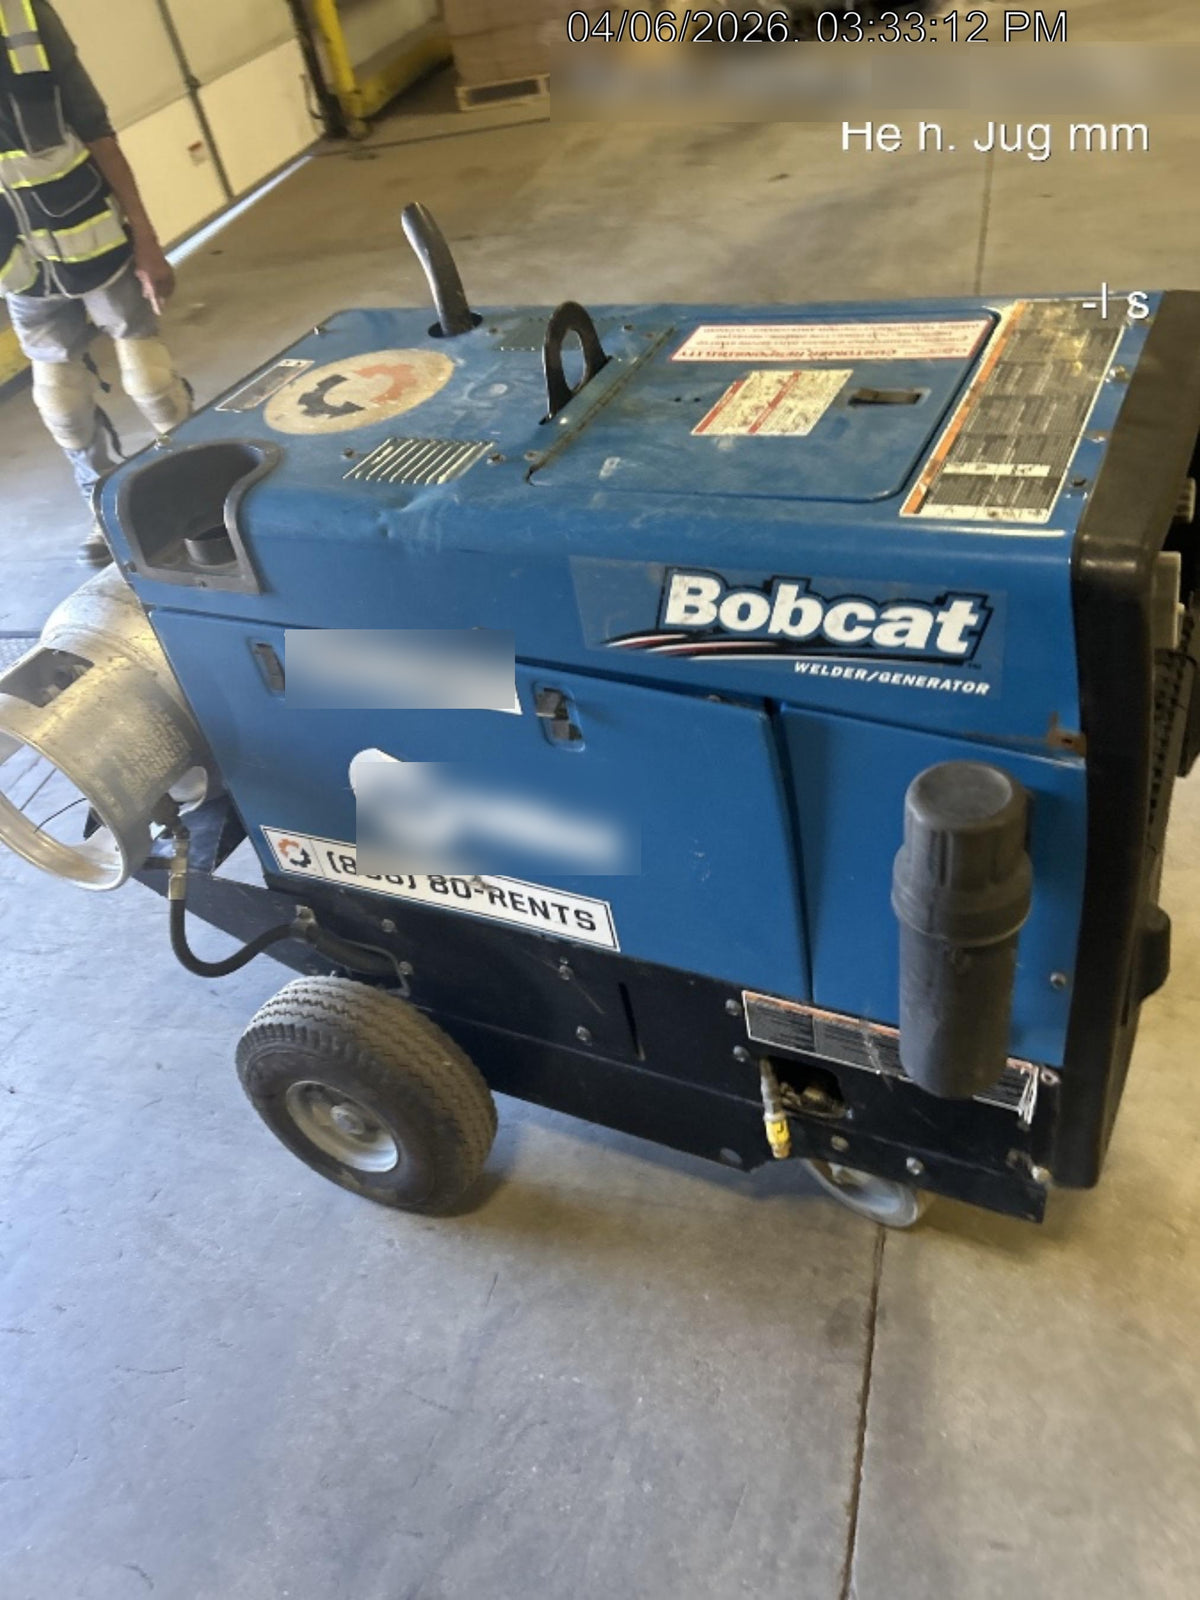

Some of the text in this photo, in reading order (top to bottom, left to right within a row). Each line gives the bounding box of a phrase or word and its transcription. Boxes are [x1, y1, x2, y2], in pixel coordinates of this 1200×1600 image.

[664, 573, 979, 656] Bobcat
[794, 661, 991, 696] WELDER/GENERATOR
[428, 875, 597, 932] 80-RENTS
